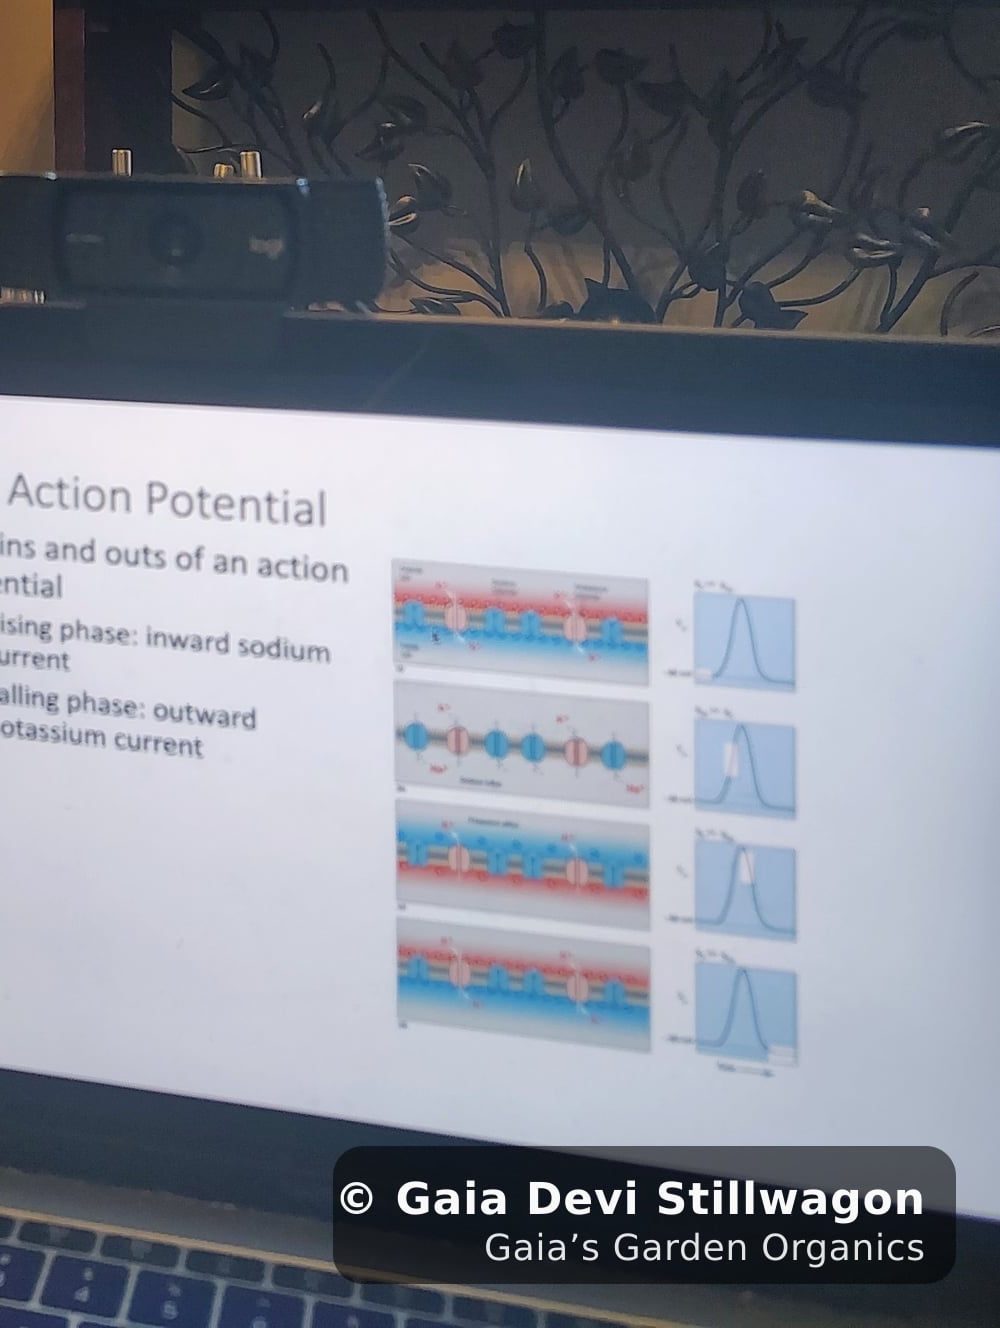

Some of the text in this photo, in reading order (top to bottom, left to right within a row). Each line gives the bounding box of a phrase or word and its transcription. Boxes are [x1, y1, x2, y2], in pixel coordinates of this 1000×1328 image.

[7, 472, 131, 513] Action
[147, 480, 326, 527] Potential
[0, 532, 36, 559] ins
[45, 538, 96, 563] and
[105, 543, 167, 570] outs
[175, 544, 205, 572] of
[213, 552, 249, 575] an
[257, 553, 350, 583] action
[60, 619, 138, 646] phase:
[146, 624, 230, 655] inward
[238, 635, 331, 664] sodium
[67, 690, 146, 720] phase:
[153, 702, 257, 730] outward
[114, 731, 205, 759] current
[74, 1285, 91, 1303] 4
